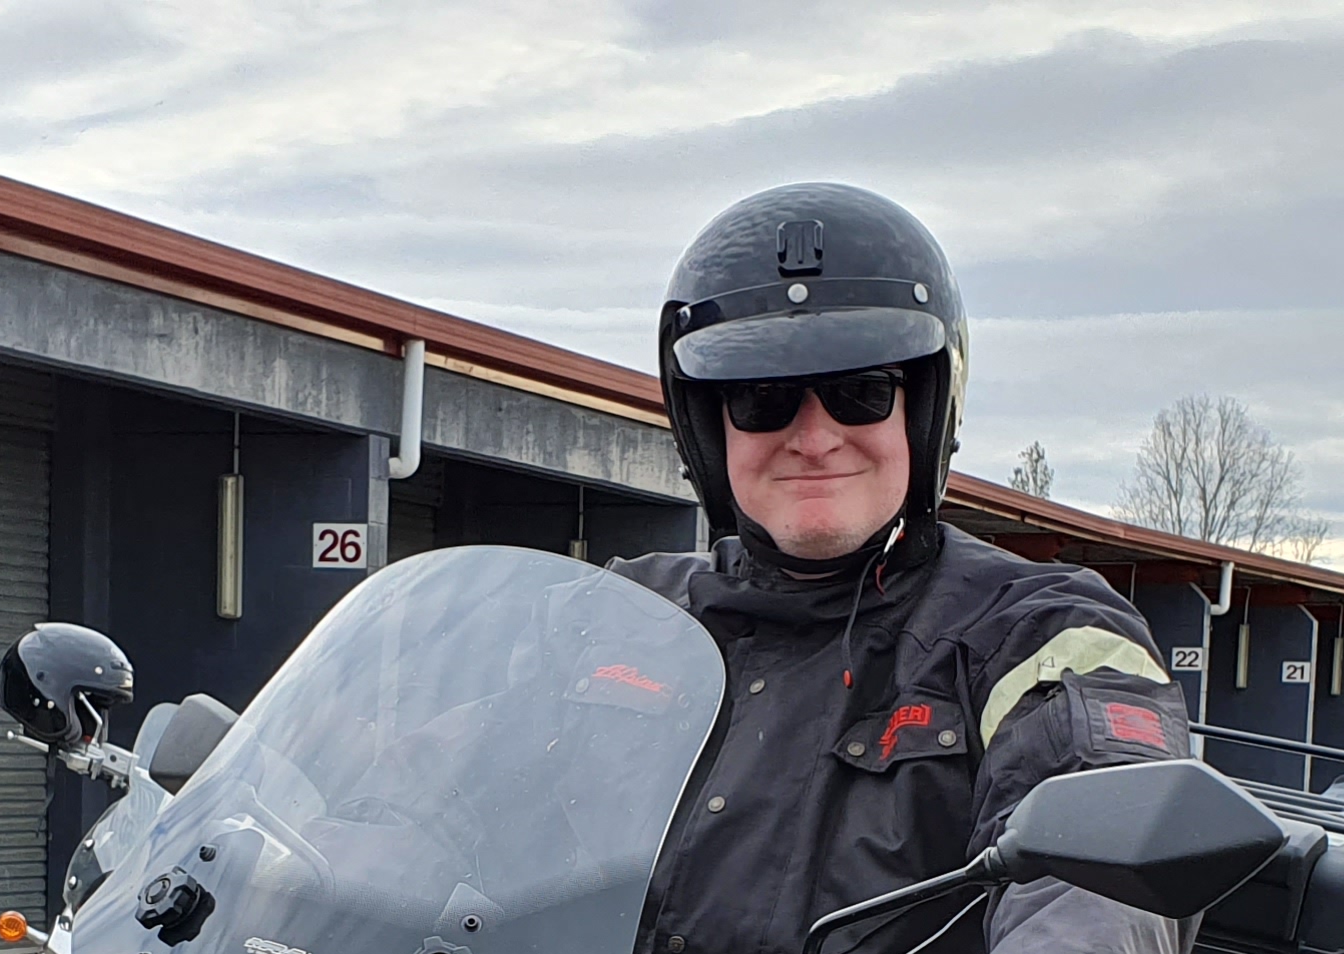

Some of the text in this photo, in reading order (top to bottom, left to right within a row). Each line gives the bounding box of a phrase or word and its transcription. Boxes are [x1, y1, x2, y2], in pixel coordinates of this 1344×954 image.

[318, 529, 362, 563] 26
[1174, 650, 1200, 668] 22
[1285, 664, 1306, 680] 21
